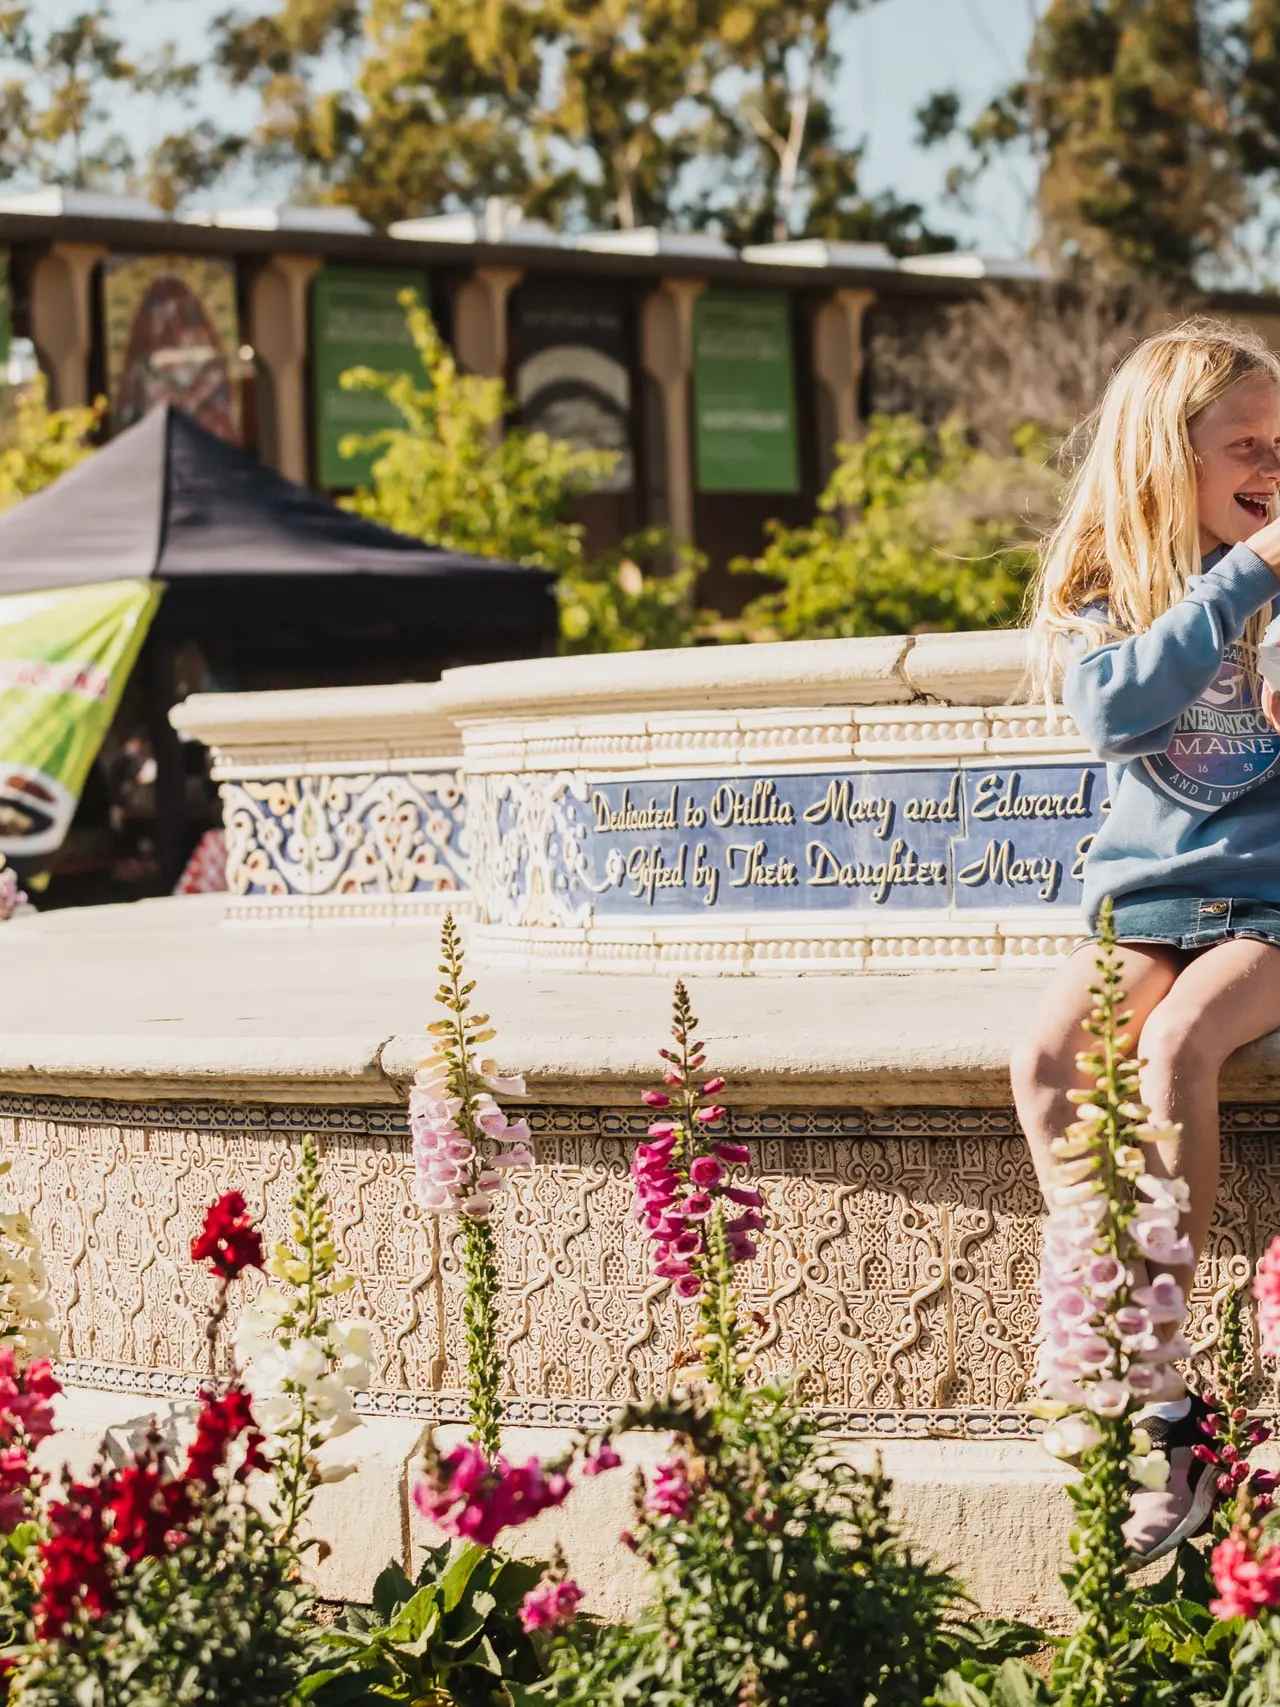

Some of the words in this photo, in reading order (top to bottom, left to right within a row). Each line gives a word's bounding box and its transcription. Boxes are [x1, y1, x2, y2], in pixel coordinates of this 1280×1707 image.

[1176, 703, 1278, 735] NEBUNKPO
[1173, 737, 1275, 755] MAINE
[1197, 764, 1209, 774] 16
[1242, 763, 1254, 772] 53
[1169, 772, 1199, 796] AND
[1207, 790, 1213, 801] I
[591, 784, 679, 832] Dedicated
[684, 796, 706, 829] to
[711, 779, 795, 826] Otillia
[803, 779, 894, 838] Mary
[904, 771, 961, 821] and
[972, 768, 1094, 821] Edward
[627, 842, 687, 907] Gifted
[693, 842, 719, 906] by
[726, 840, 798, 888] Their
[806, 838, 947, 904] Daughter
[958, 838, 1063, 902] Mary
